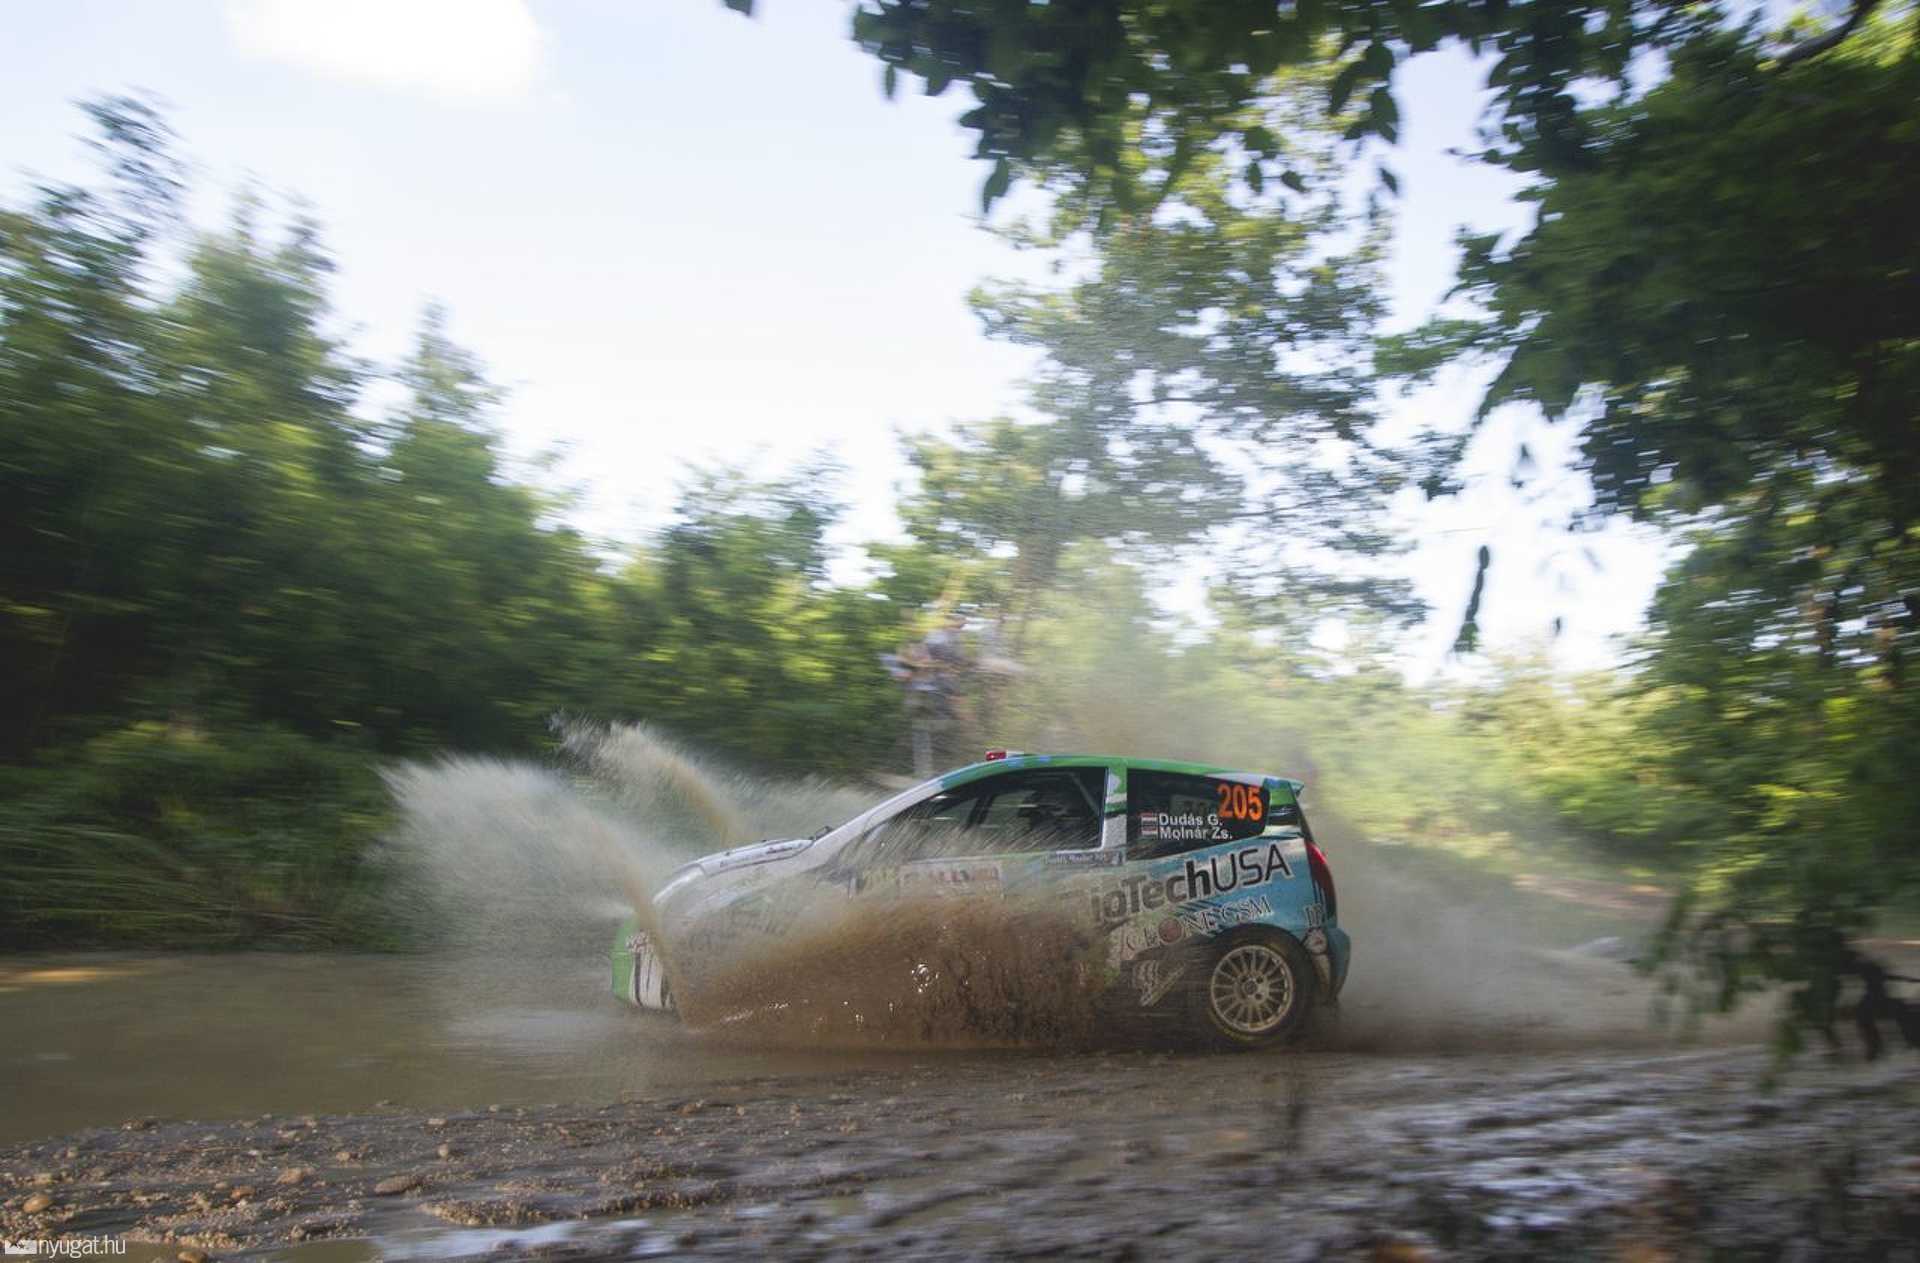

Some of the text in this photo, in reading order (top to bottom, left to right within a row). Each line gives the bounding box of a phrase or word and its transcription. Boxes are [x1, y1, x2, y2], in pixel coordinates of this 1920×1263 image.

[1217, 783, 1264, 821] 205
[1159, 813, 1223, 826] Dudás G.
[1159, 826, 1233, 840] Molnár Zs.
